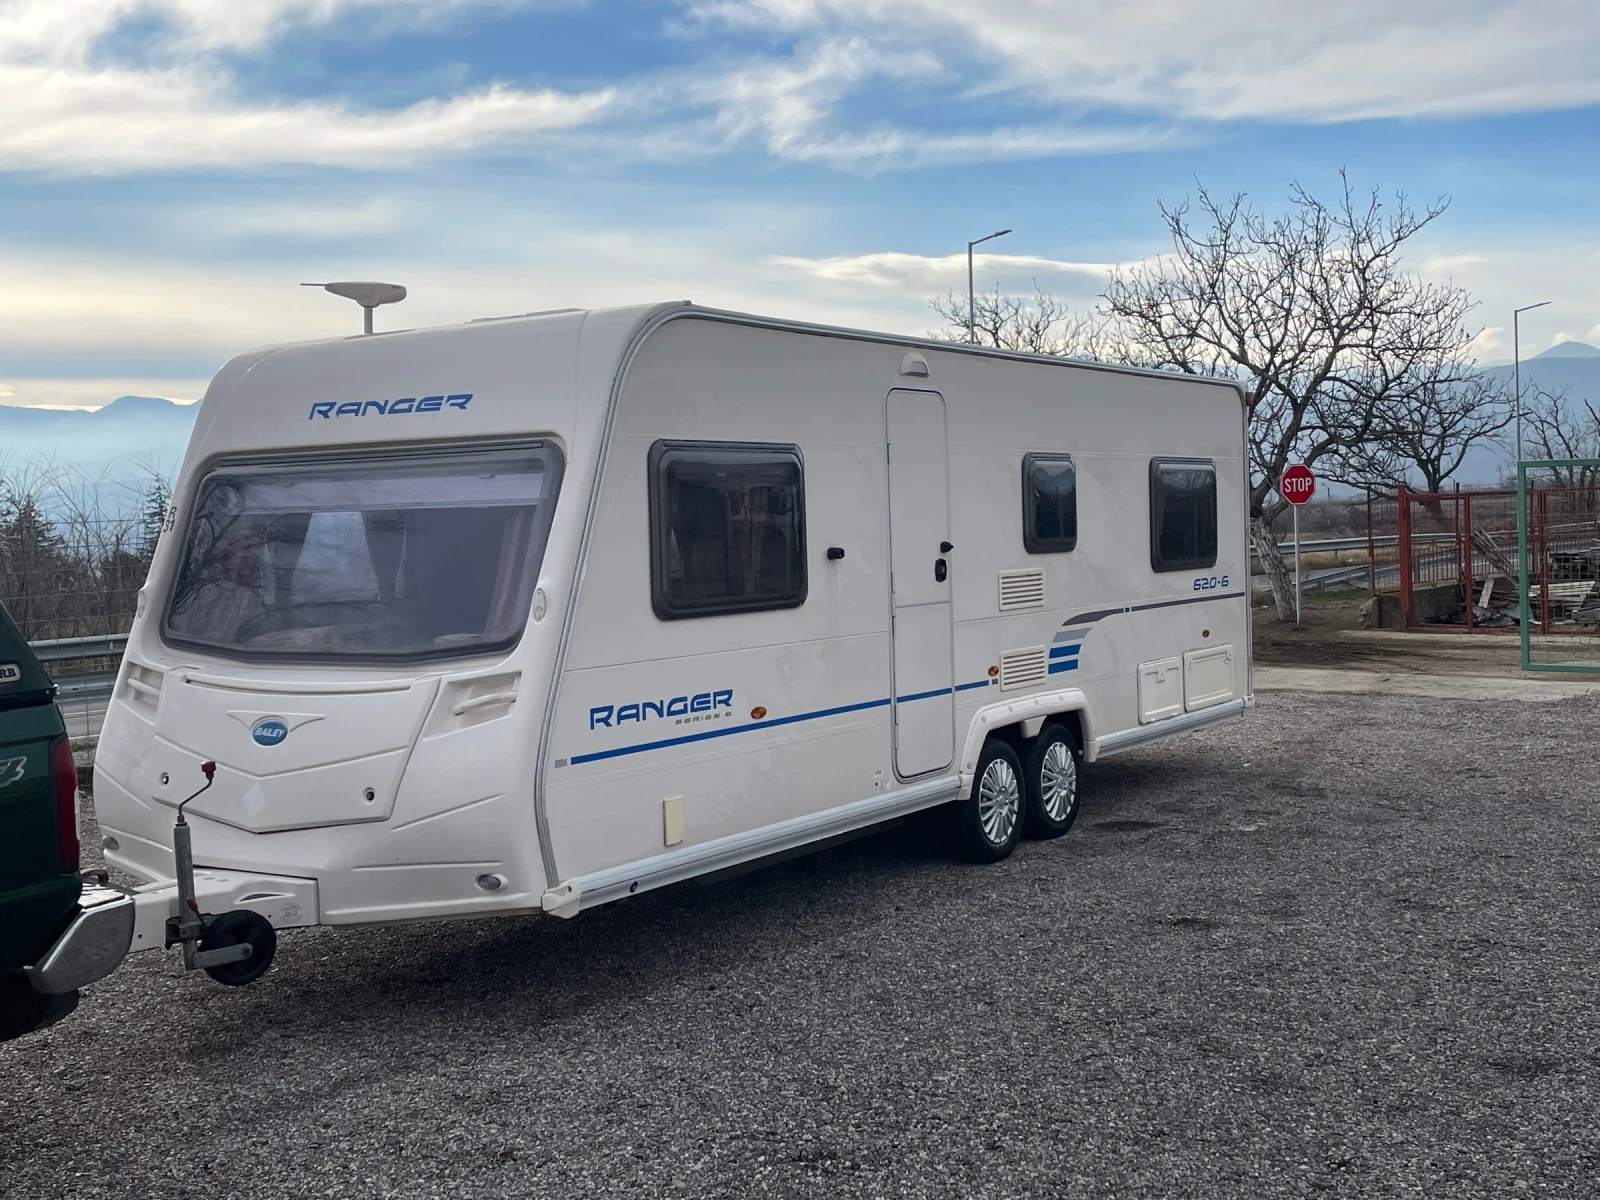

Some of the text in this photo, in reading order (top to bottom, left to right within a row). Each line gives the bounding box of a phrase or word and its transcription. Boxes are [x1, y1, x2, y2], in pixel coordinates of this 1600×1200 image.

[309, 394, 473, 420] RANGER
[1284, 478, 1312, 493] STOP
[1193, 575, 1229, 591] 620-6
[590, 689, 733, 730] RANGER
[675, 713, 720, 725] SERIES
[254, 727, 285, 737] BAILEY
